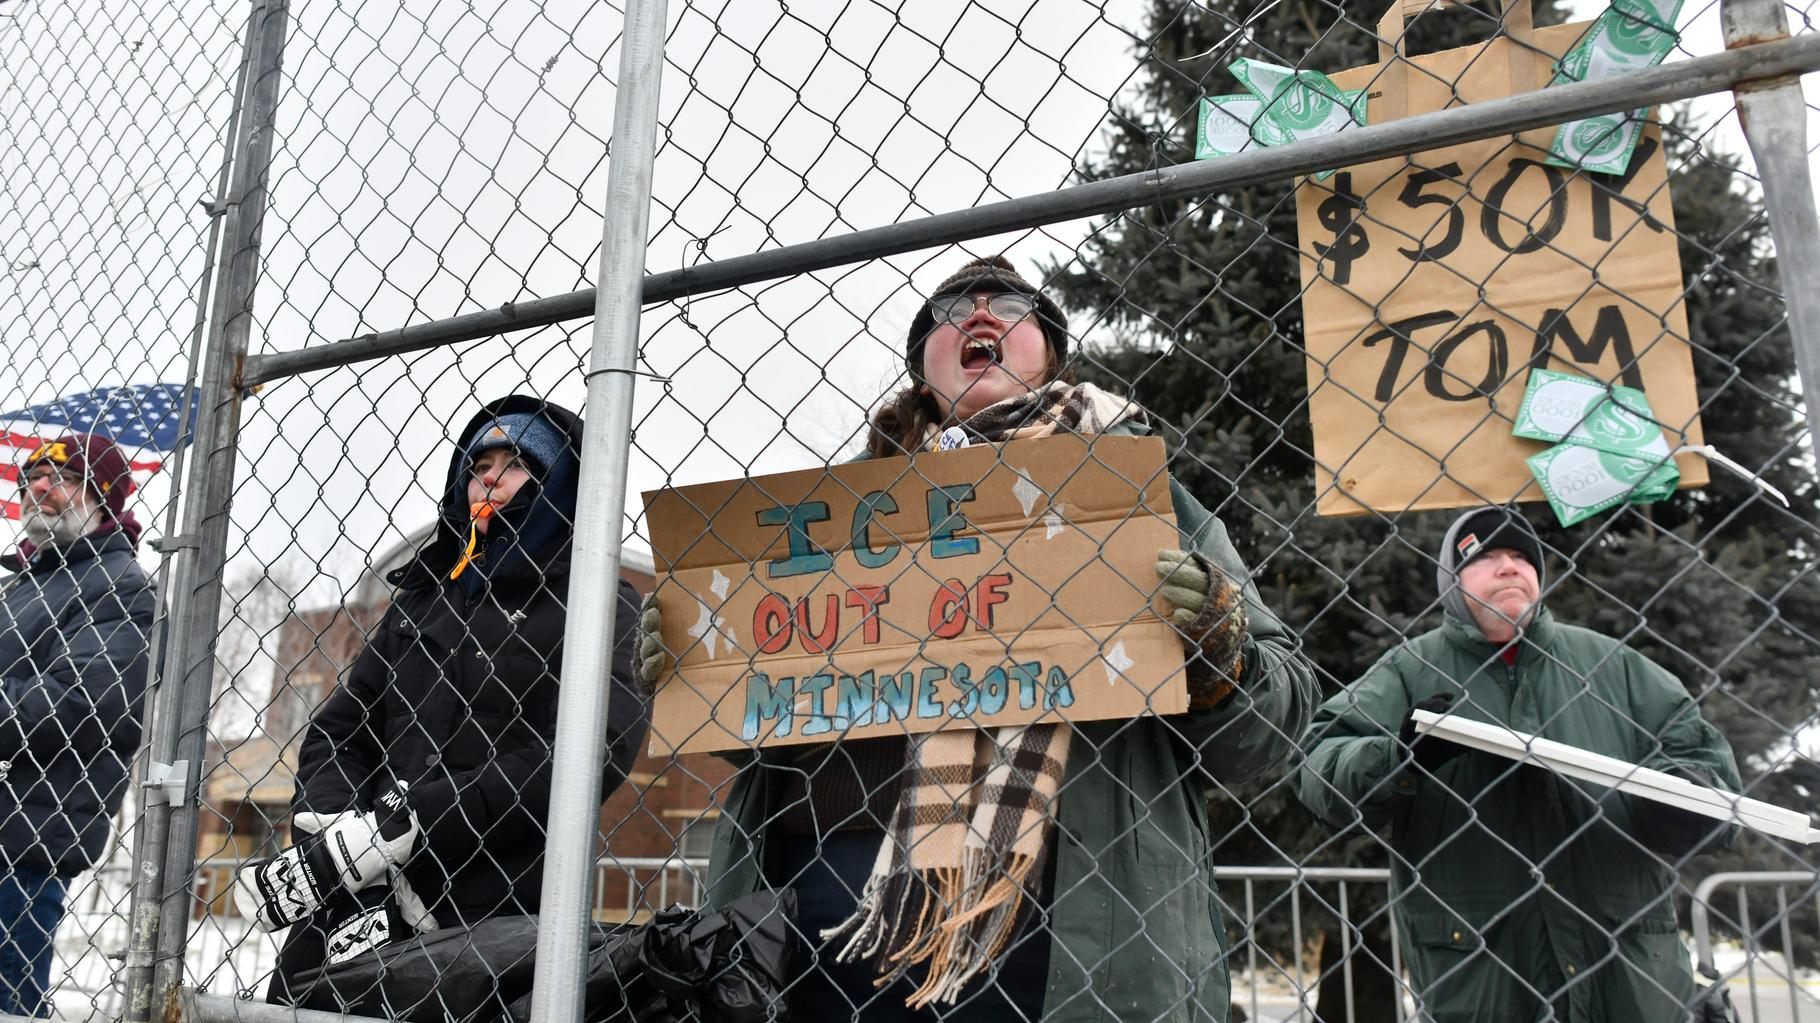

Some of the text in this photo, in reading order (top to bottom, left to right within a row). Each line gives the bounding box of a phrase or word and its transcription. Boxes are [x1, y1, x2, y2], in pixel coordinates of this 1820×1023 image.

[1312, 137, 1665, 286] $50K
[1362, 304, 1646, 403] TOM
[755, 482, 981, 579] ICE
[752, 571, 1013, 655] OUT OF
[742, 660, 1076, 742] MINNESOTA
